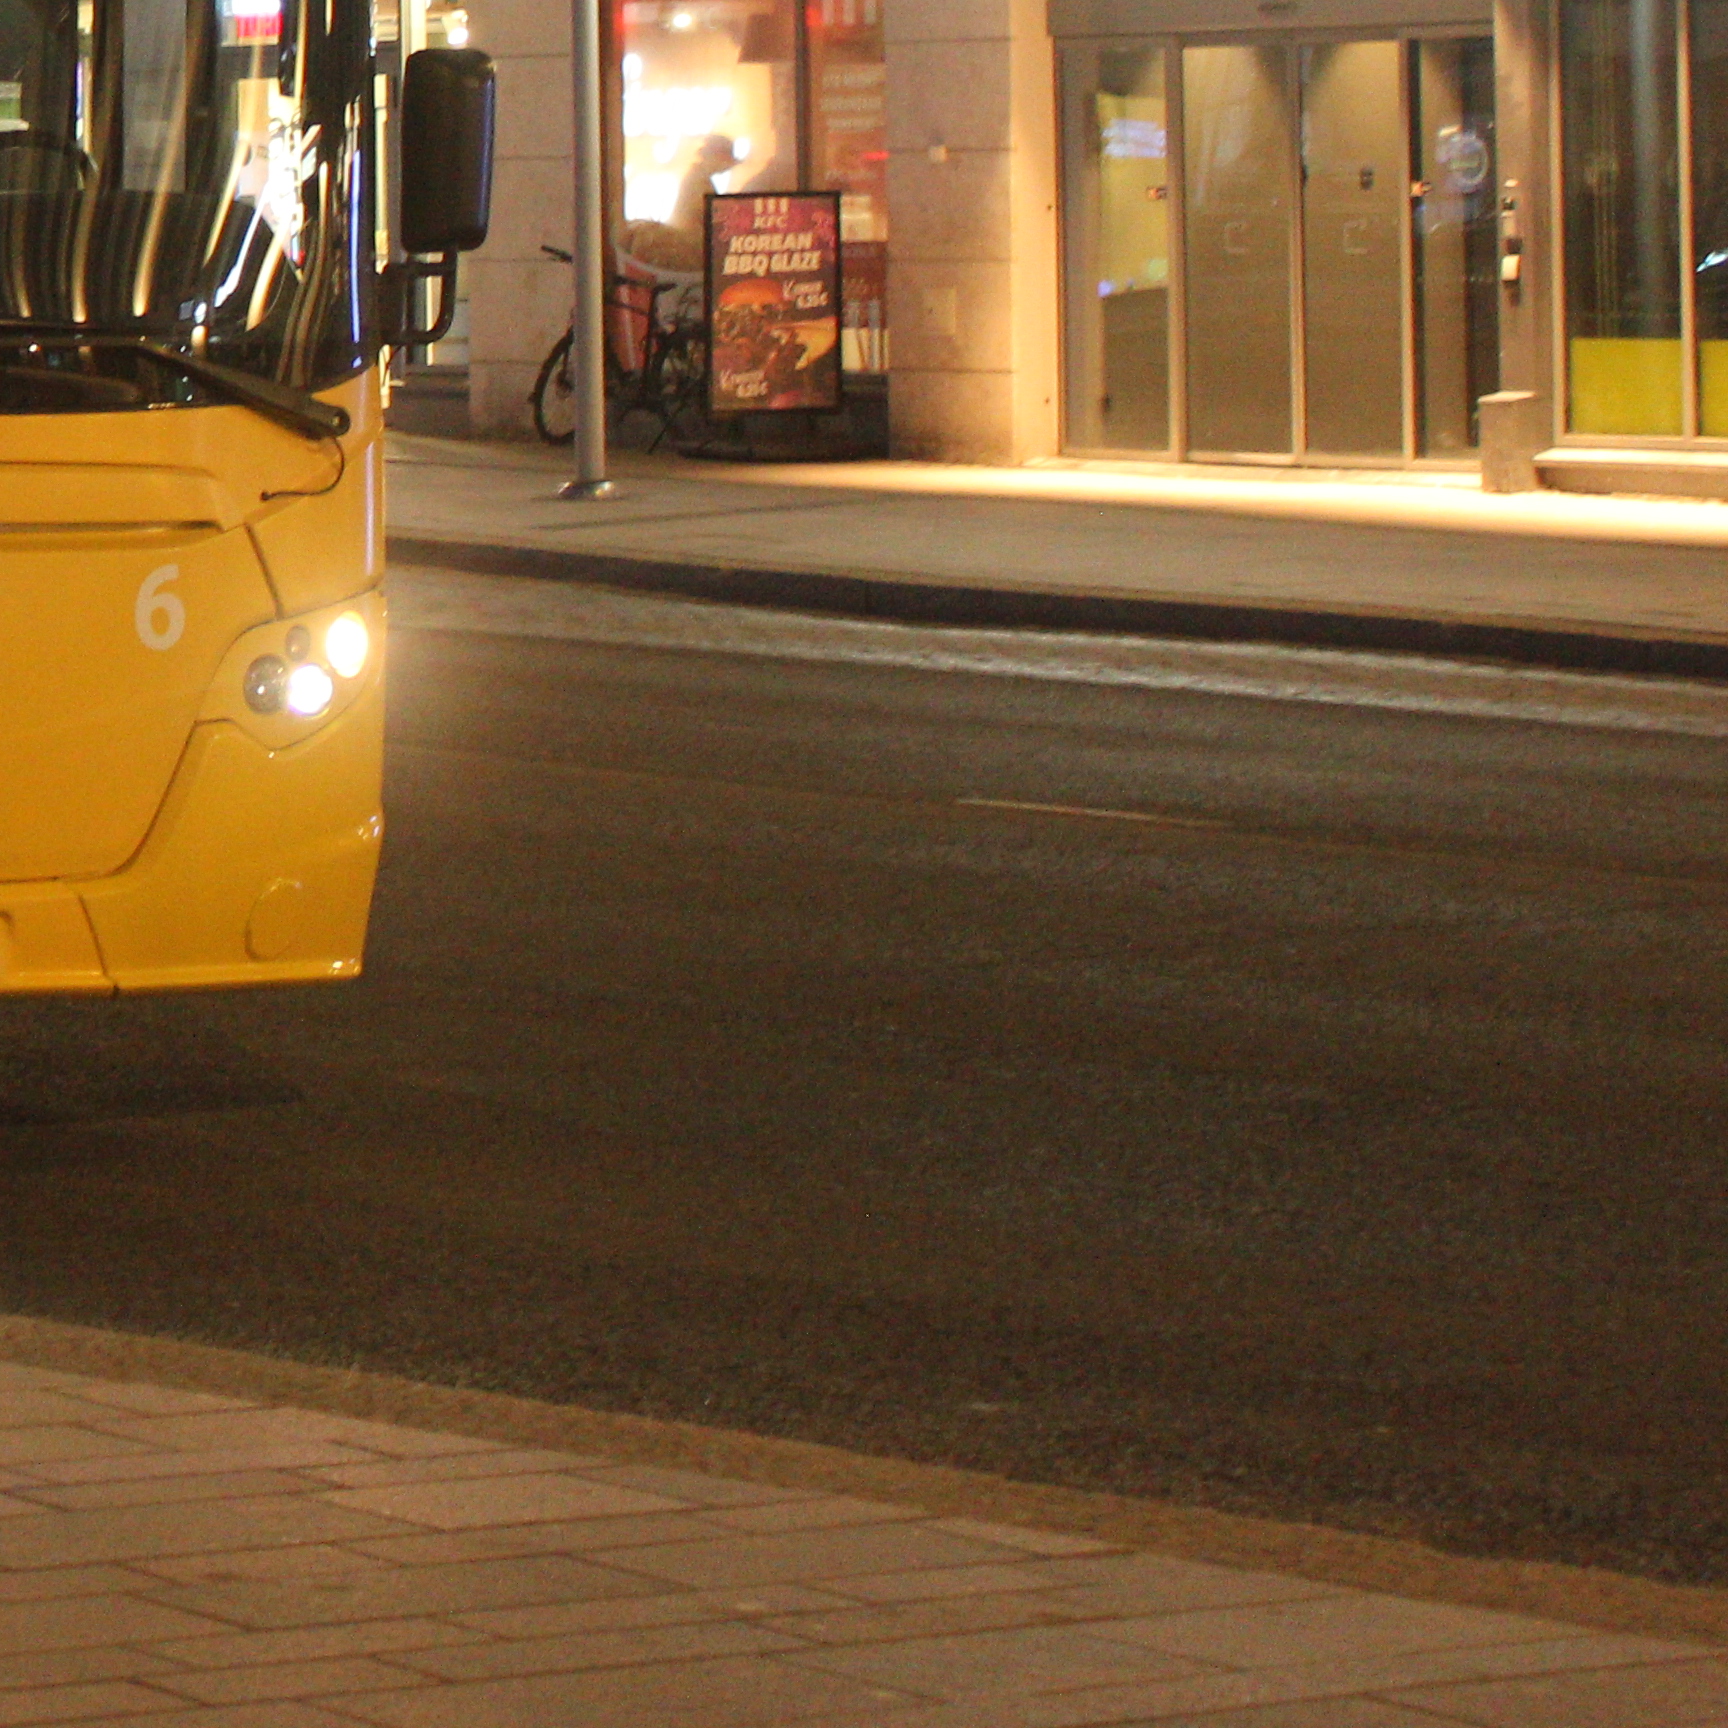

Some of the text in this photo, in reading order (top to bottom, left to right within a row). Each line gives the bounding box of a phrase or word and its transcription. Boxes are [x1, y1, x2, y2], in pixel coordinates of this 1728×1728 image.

[753, 215, 788, 229] KFC
[730, 232, 814, 254] KOREAN
[722, 250, 822, 277] BBQ GLAZE
[134, 563, 187, 653] 6
